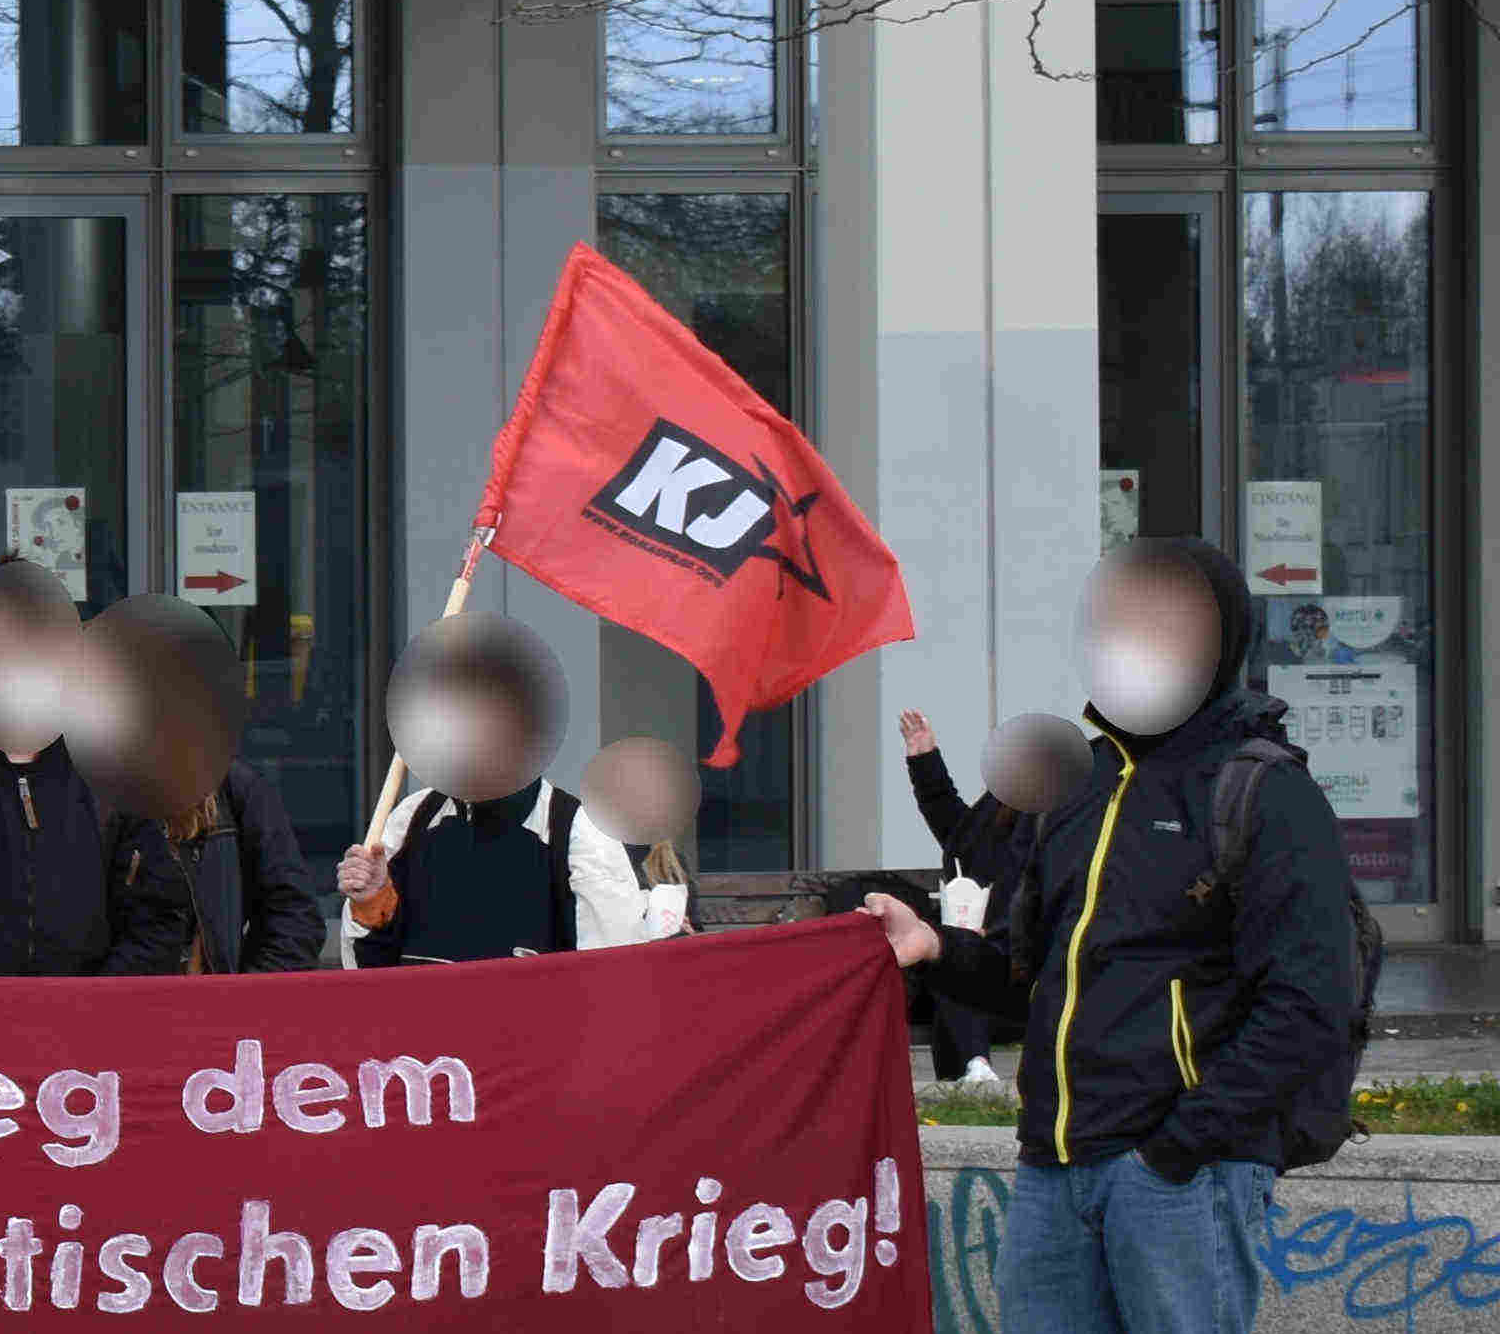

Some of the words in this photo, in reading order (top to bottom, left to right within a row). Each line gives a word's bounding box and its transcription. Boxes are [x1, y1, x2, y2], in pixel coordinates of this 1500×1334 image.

[613, 436, 771, 549] KJ
[181, 1038, 477, 1135] dem
[541, 1156, 903, 1310] Krieg!
